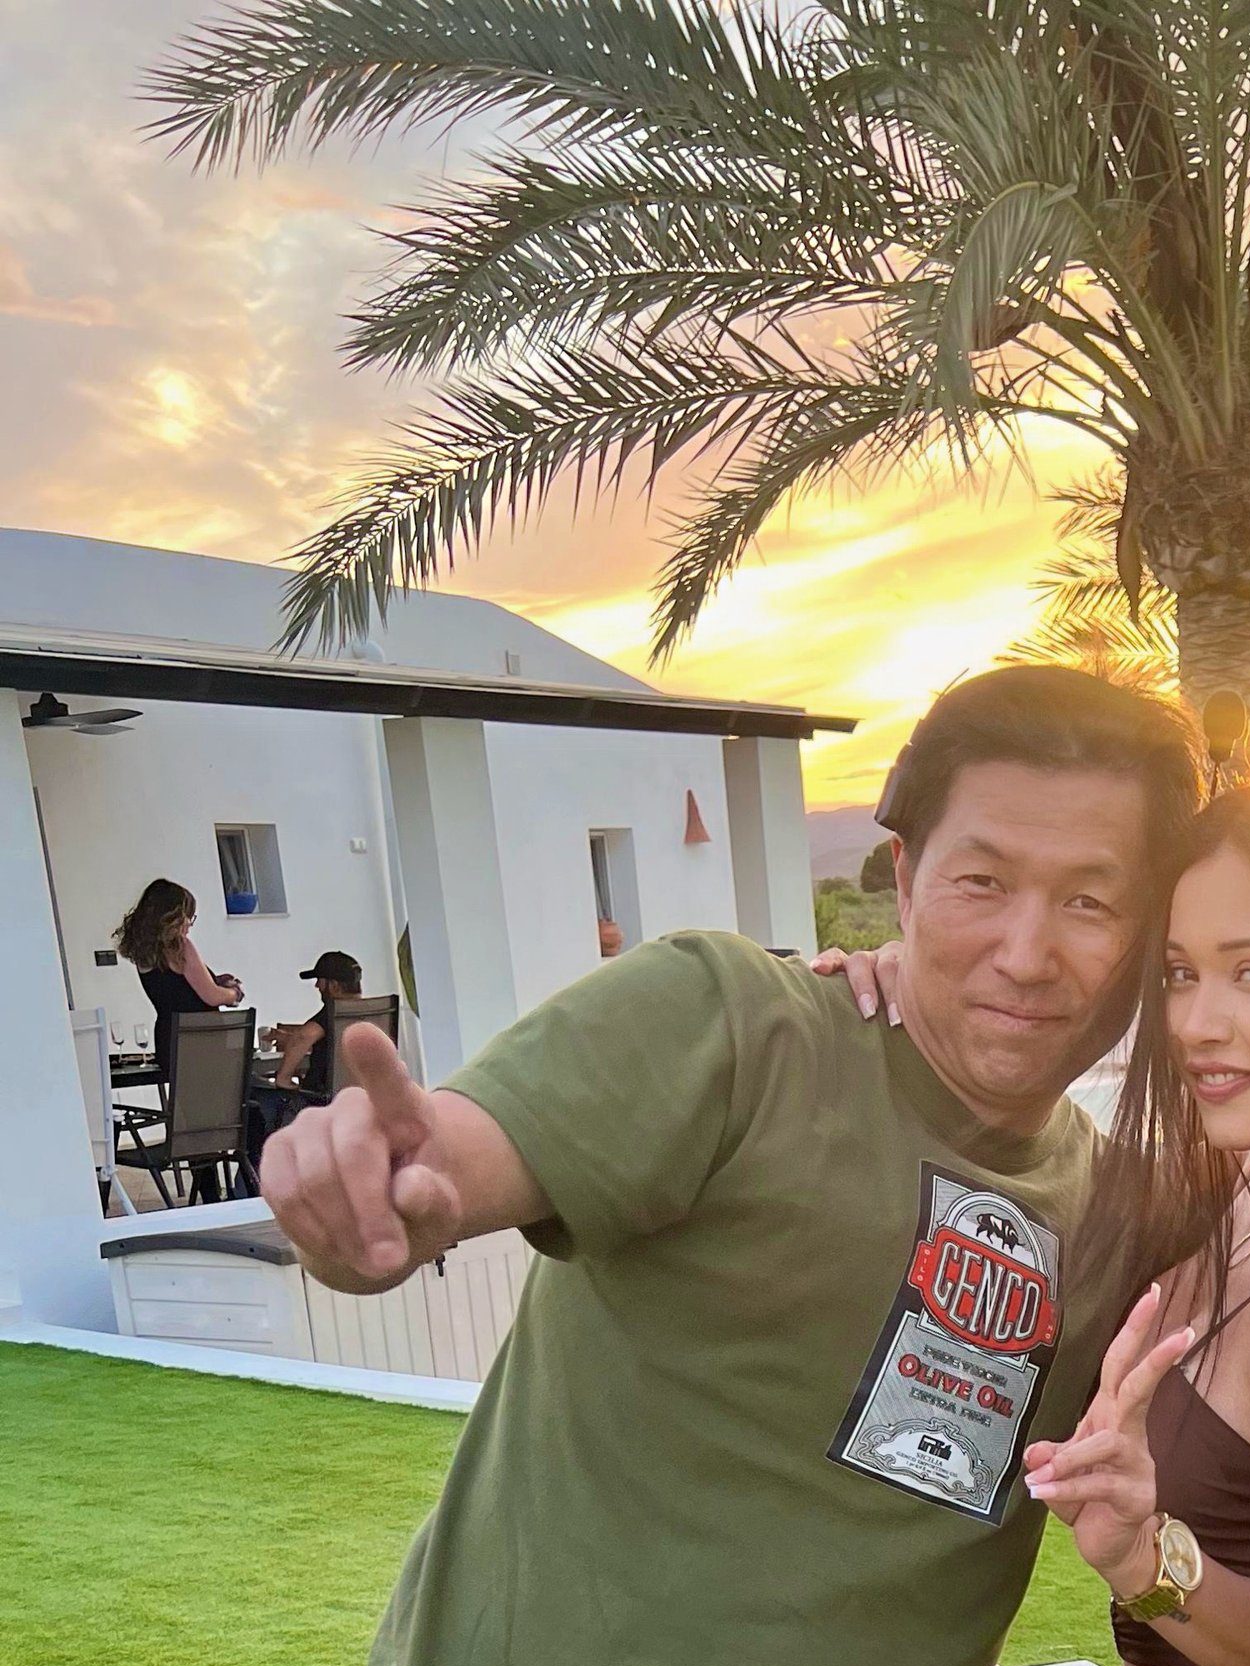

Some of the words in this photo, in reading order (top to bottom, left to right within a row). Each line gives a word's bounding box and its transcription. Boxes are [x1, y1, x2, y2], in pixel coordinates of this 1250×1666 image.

[932, 1241, 1041, 1341] GENCO
[897, 1353, 975, 1402] OLIVE
[977, 1385, 1014, 1418] OIL
